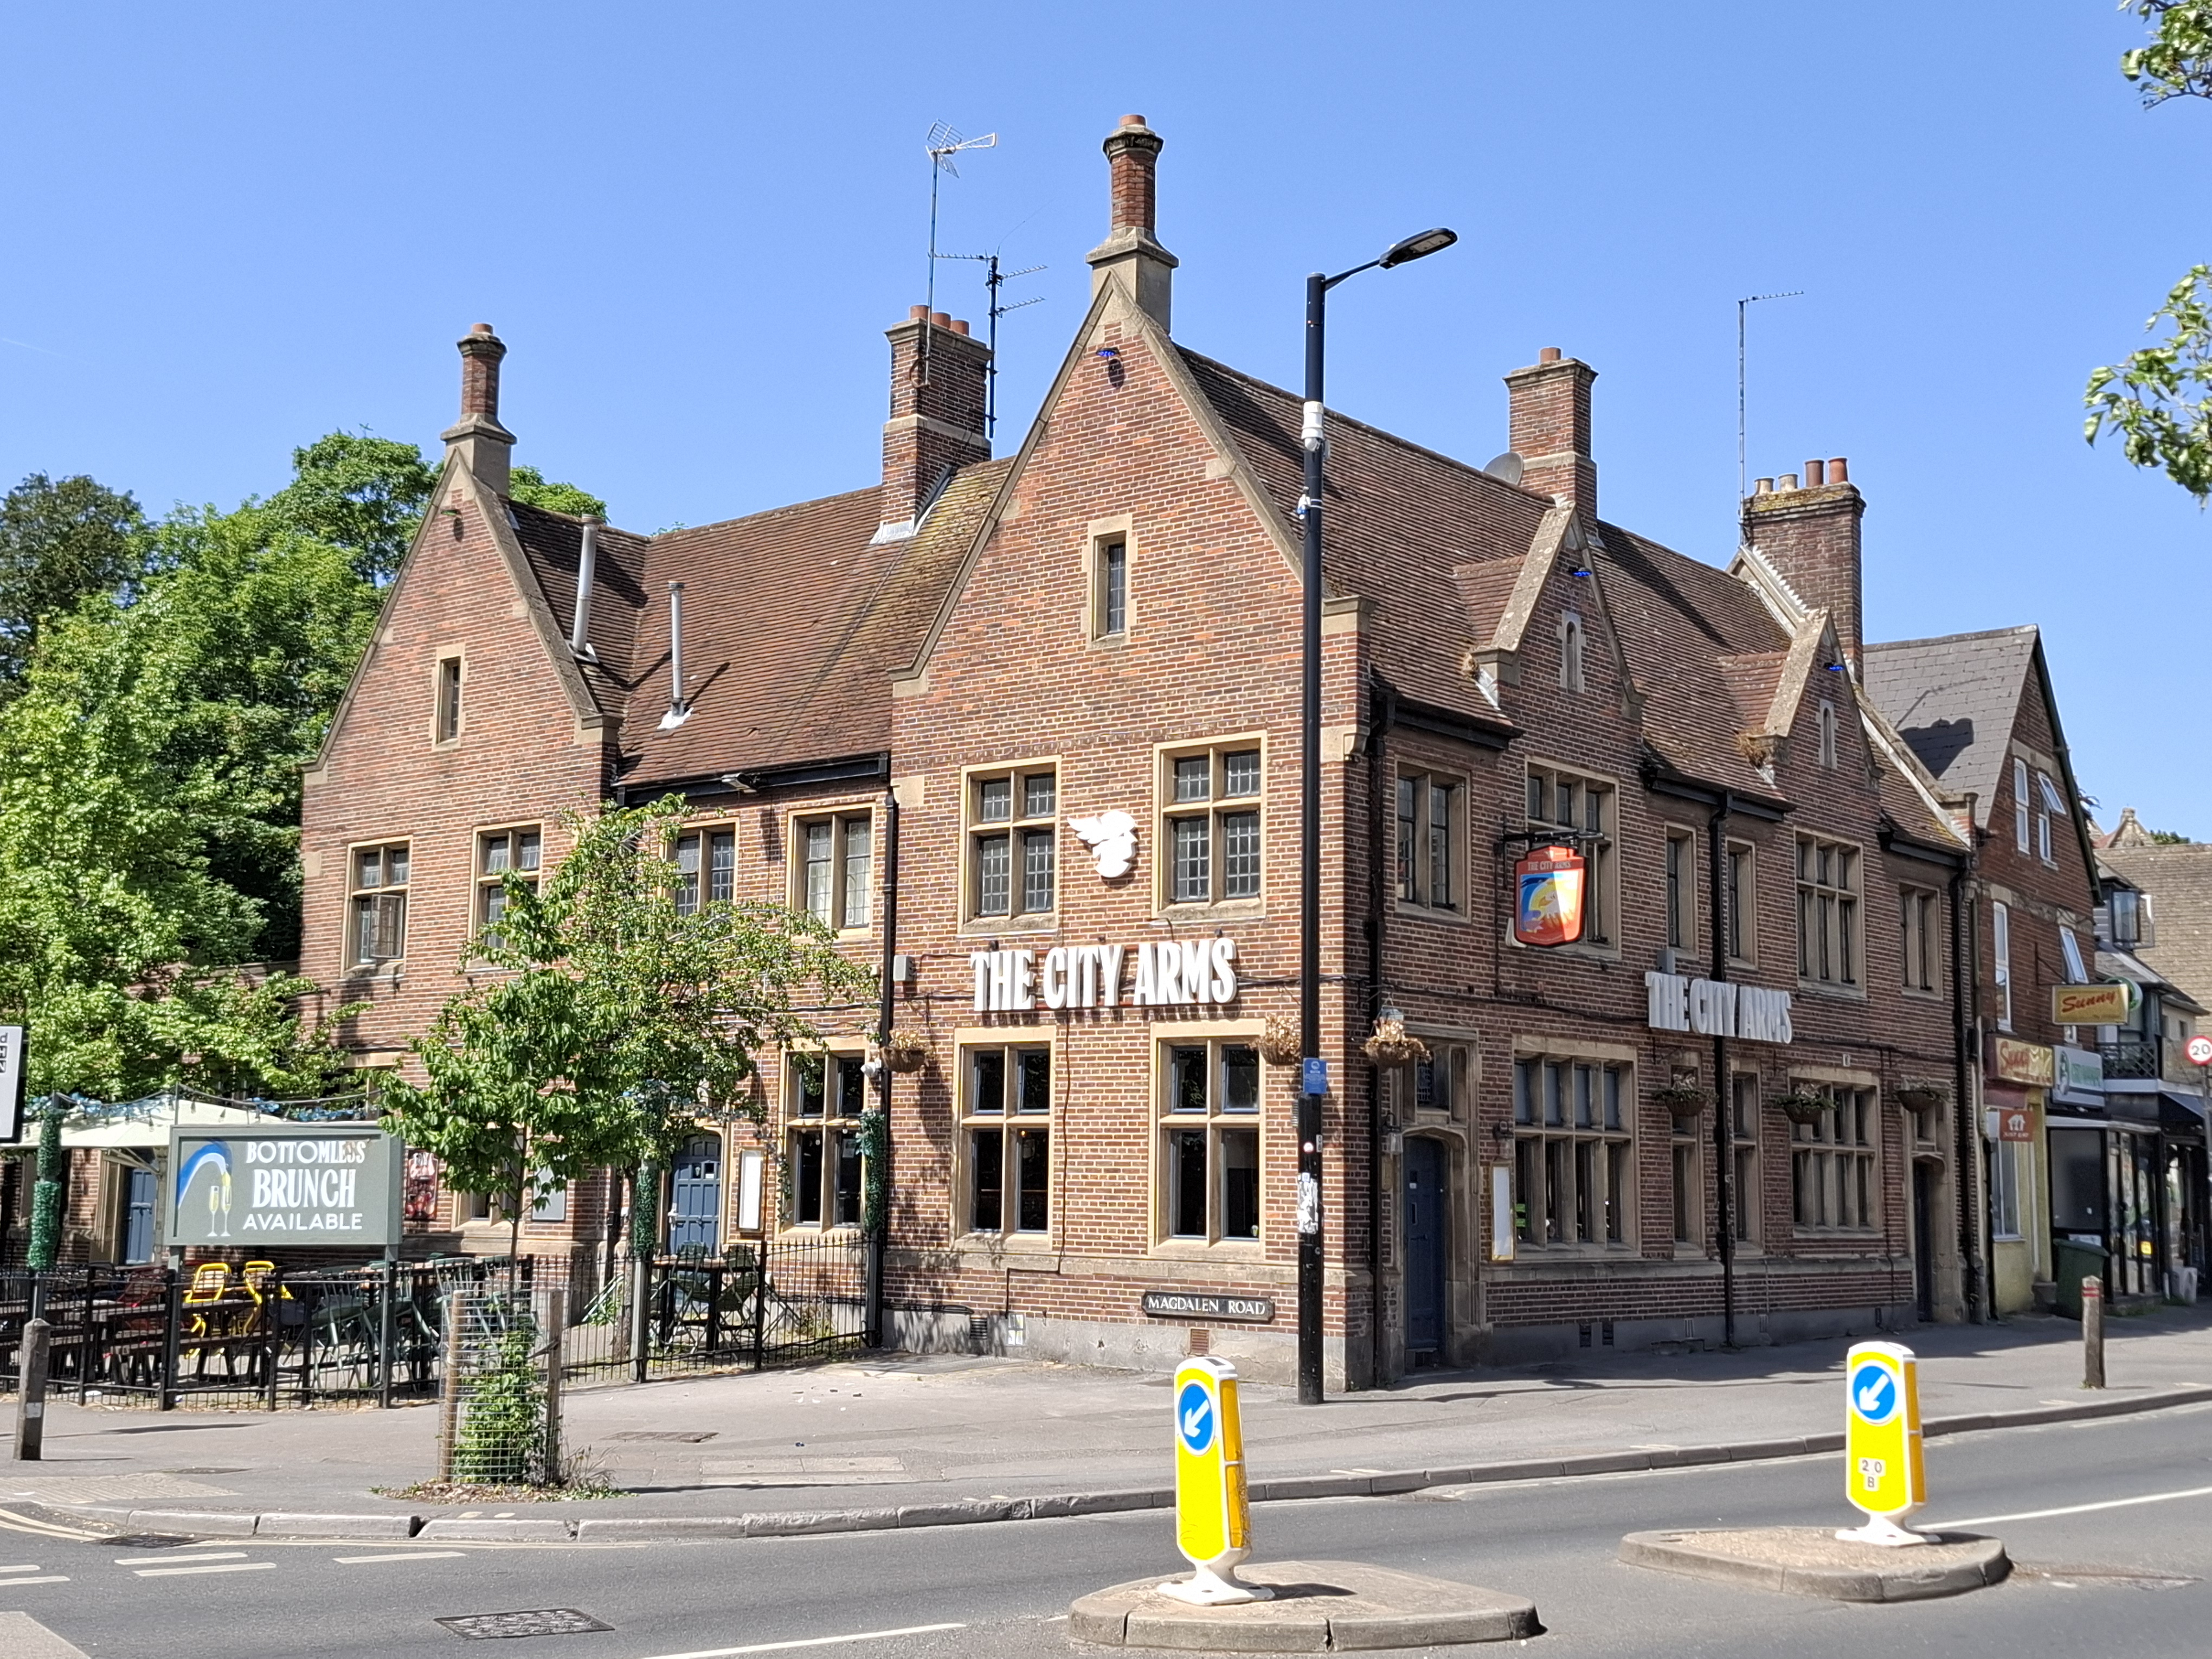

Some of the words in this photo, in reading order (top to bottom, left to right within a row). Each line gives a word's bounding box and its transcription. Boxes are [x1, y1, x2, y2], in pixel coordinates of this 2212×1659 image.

[970, 950, 1036, 1011] THE
[1043, 945, 1125, 1009] CITY
[1133, 938, 1238, 1006] ARMS
[1645, 971, 1689, 1032] THE
[1690, 978, 1737, 1037] CITY
[1738, 986, 1792, 1044] ARMS
[2062, 991, 2116, 1013] Sunny
[2191, 1044, 2211, 1056] 20
[246, 1141, 366, 1163] BOTTOMLESS
[252, 1169, 356, 1208] BRUNCH
[242, 1213, 363, 1230] AVAILABLE
[1148, 1297, 1219, 1312] MAGDALEN
[1228, 1300, 1265, 1315] ROAD
[1862, 1459, 1882, 1474] 20
